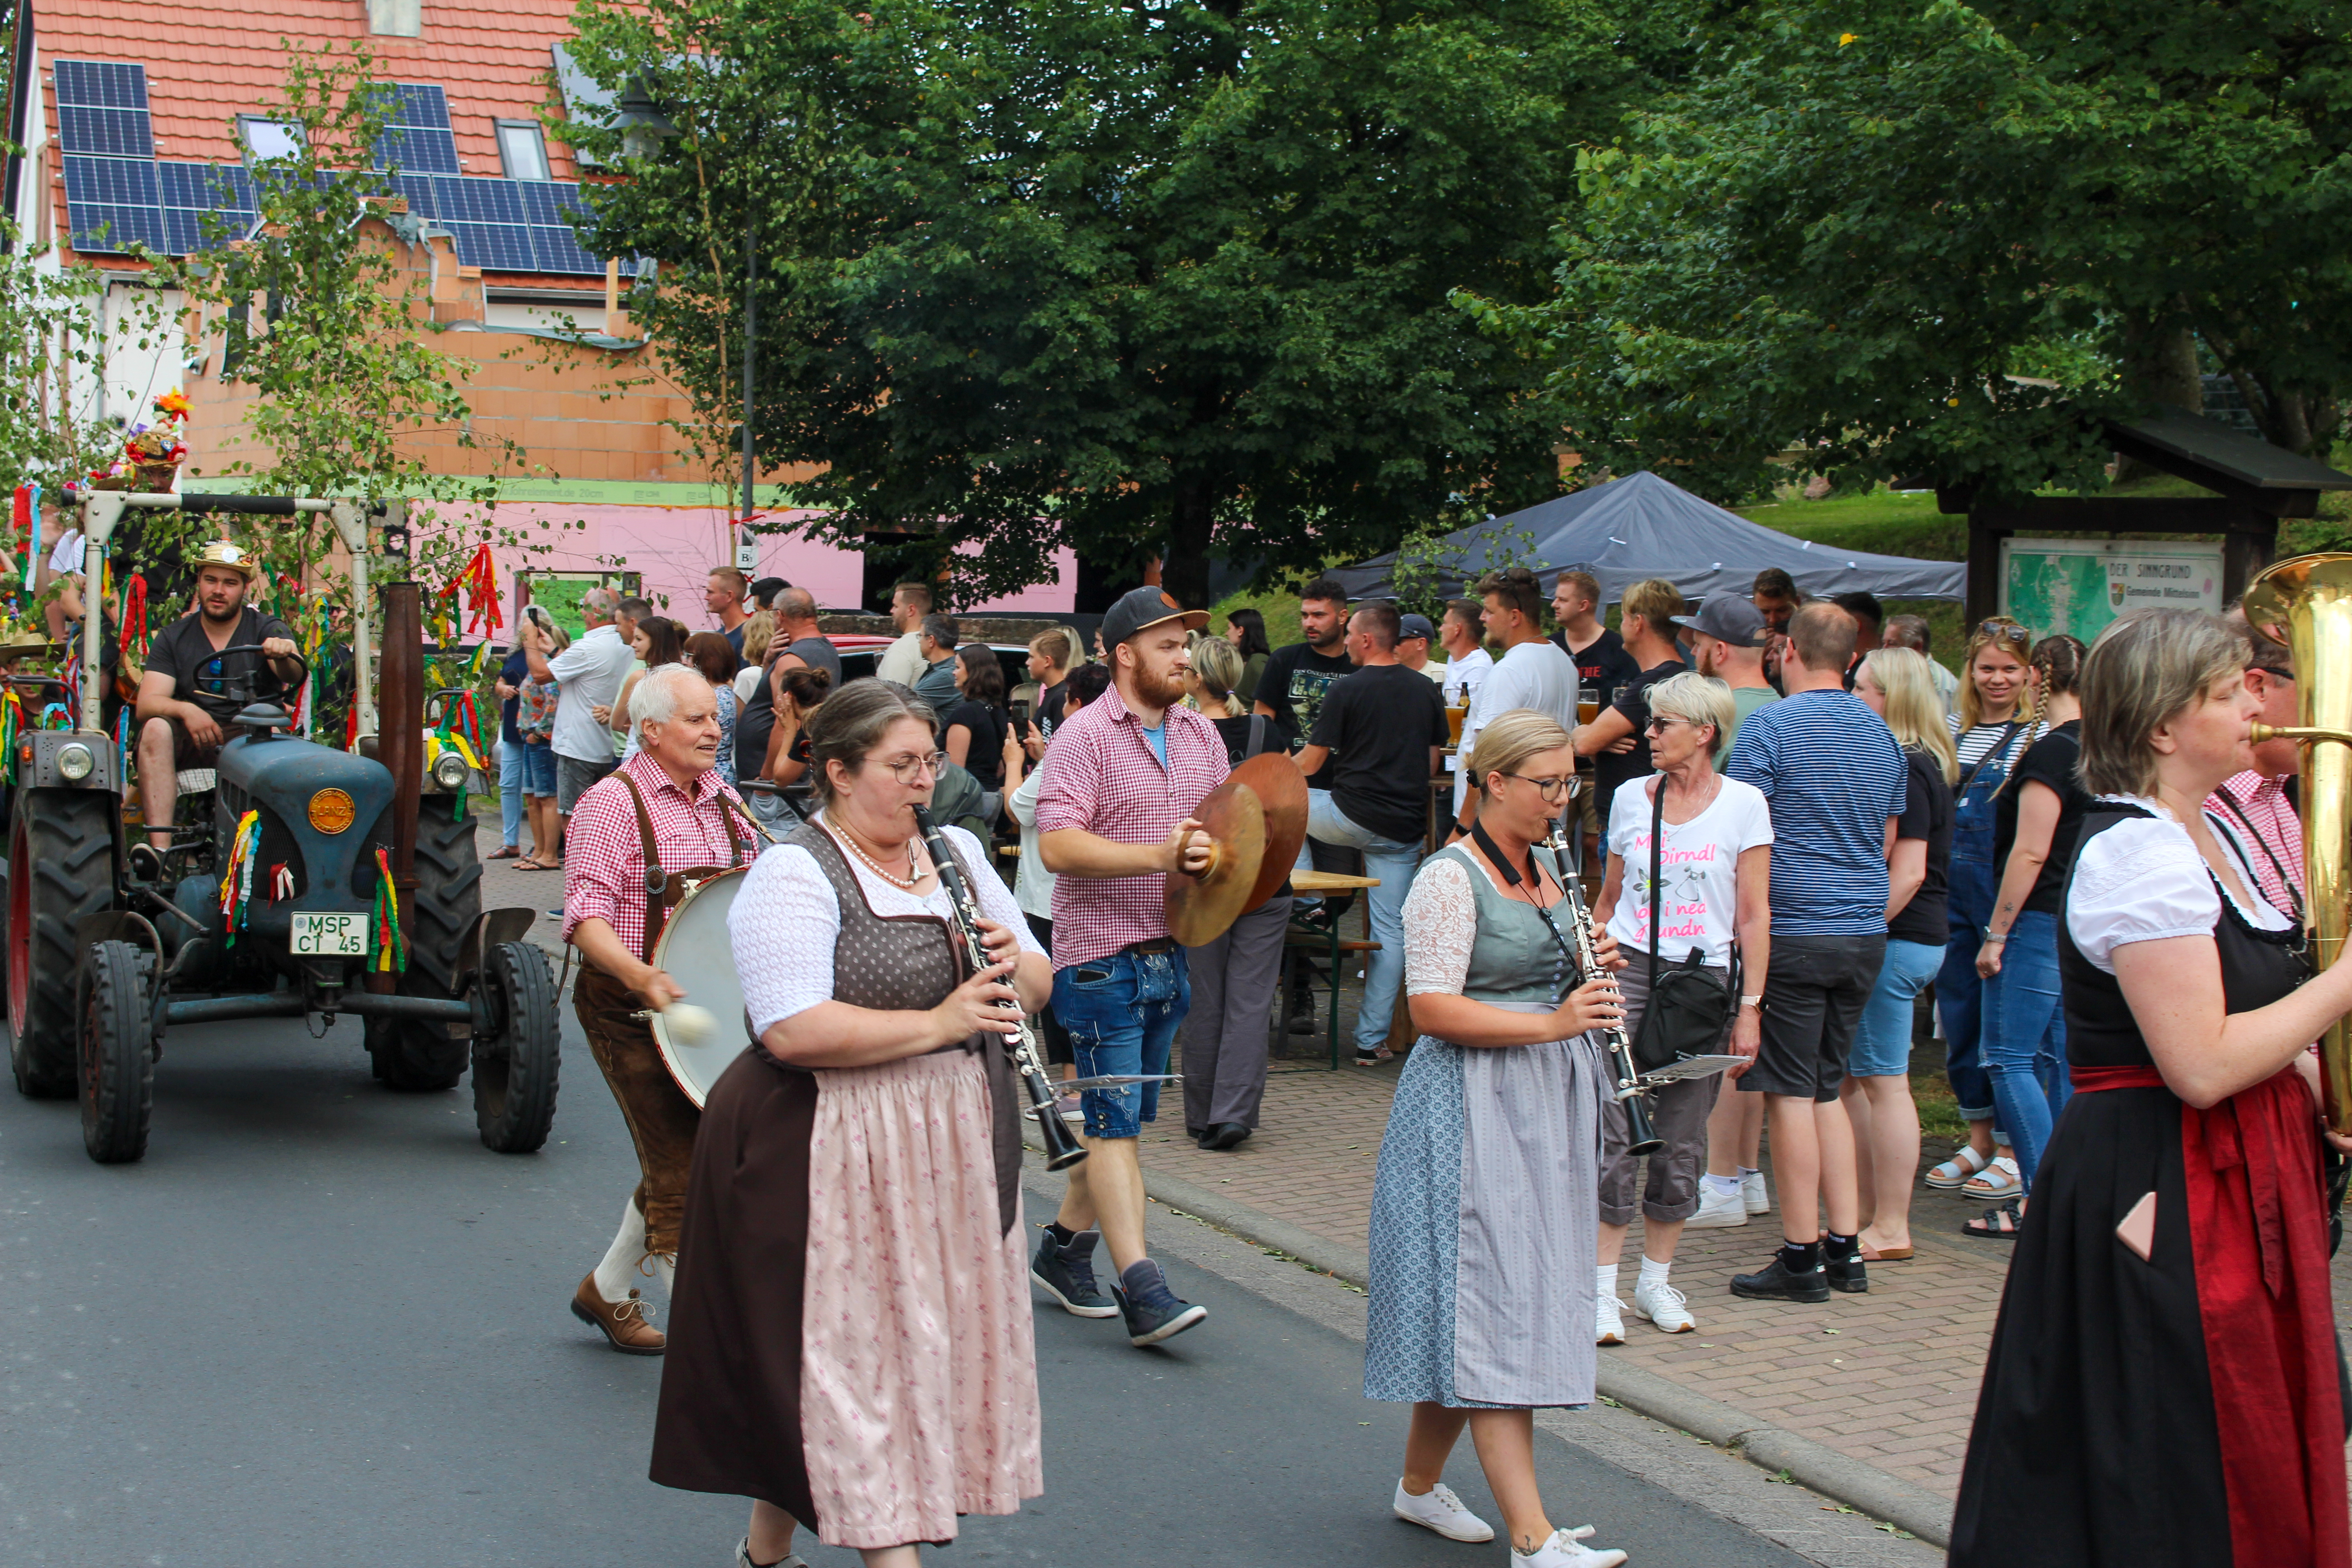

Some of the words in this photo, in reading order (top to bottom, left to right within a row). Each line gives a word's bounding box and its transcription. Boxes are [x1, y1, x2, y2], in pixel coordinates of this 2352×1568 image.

[2110, 563, 2128, 577] DER
[2137, 564, 2192, 578] SINNGRUND
[2126, 586, 2162, 597] Gemeinde
[2164, 587, 2200, 599] Mittelsinn
[318, 806, 346, 817] LANZ
[1634, 830, 1668, 851] Mi
[309, 916, 351, 933] MSP
[1632, 918, 1706, 943] gundn
[299, 935, 323, 952] CT
[338, 936, 360, 953] 45
